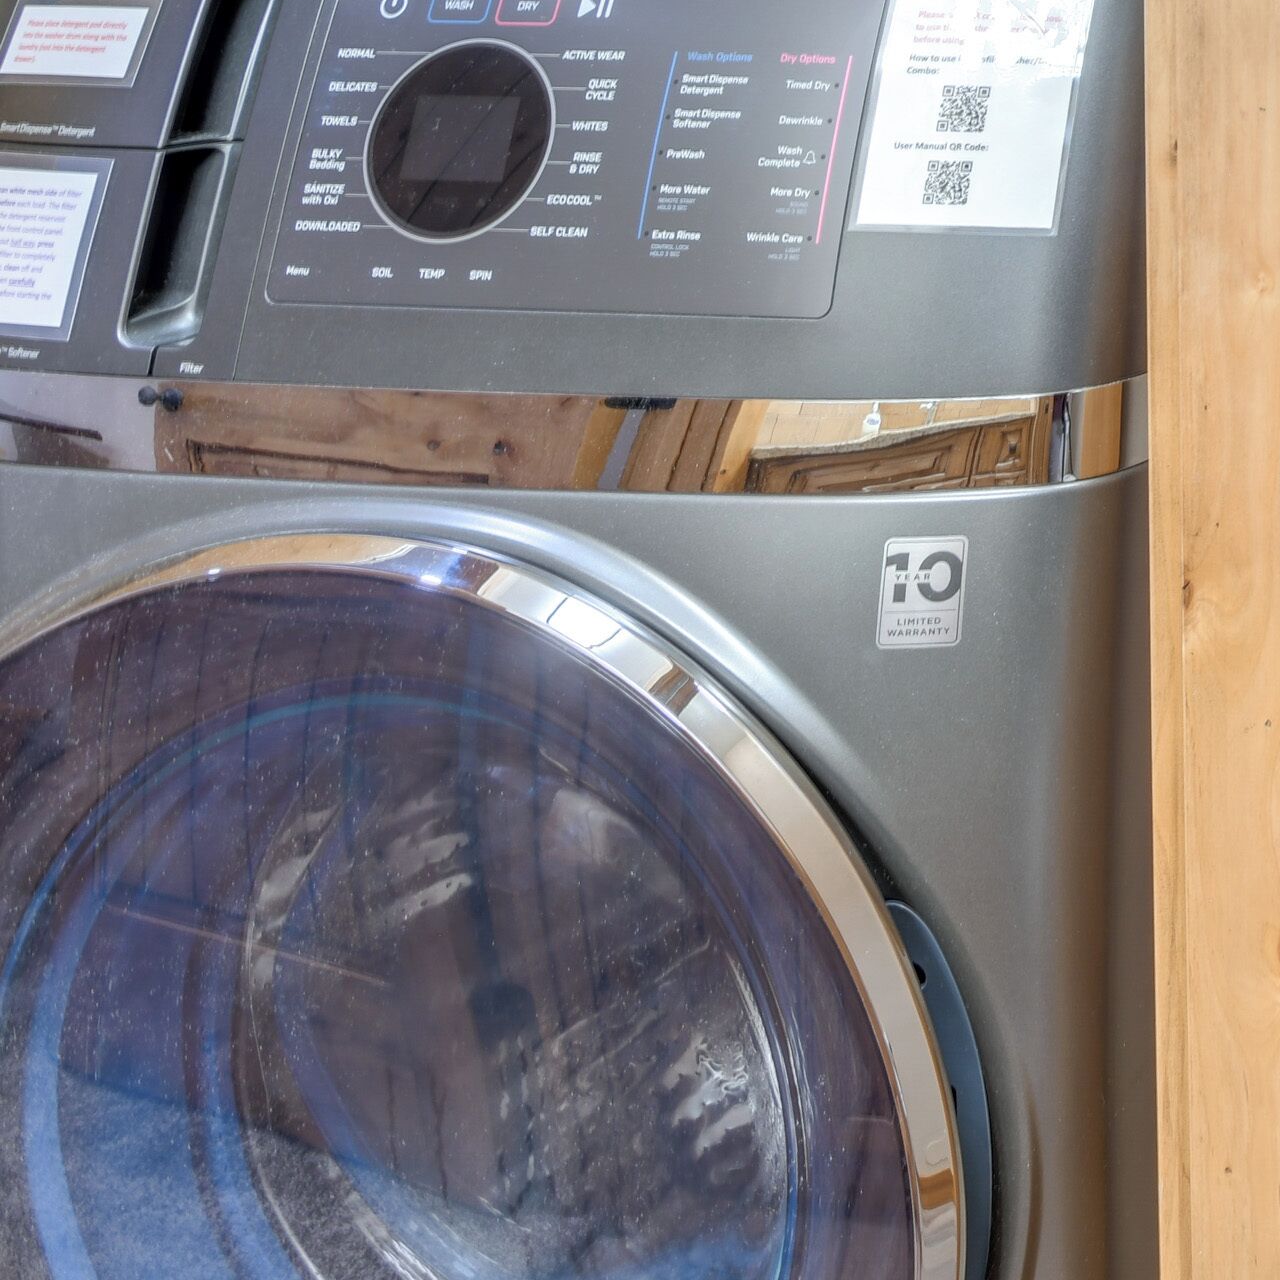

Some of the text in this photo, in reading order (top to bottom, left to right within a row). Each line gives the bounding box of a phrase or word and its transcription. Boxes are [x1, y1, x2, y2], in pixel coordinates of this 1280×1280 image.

[445, 0, 474, 11] WASH
[517, 1, 540, 12] DRY
[913, 35, 941, 45] before
[338, 48, 376, 59] NORMAL
[562, 50, 625, 61] ACTIVE WEAR
[687, 51, 753, 63] Wash Options
[780, 53, 836, 65] Dry Options
[909, 54, 929, 62] How
[906, 66, 940, 75] Combo:
[588, 78, 618, 90] QUICK
[682, 73, 749, 85] Smart Dispense
[329, 81, 378, 93] DELICATES
[680, 85, 724, 96] Detergent
[786, 80, 831, 92] Timed Dry
[585, 90, 616, 101] CYCLE
[674, 108, 741, 120] Smart Dispense
[321, 116, 359, 127] TOWELS
[672, 119, 712, 129] Softener
[779, 115, 823, 126] Dewrinkle
[572, 121, 609, 132] WHITES
[58, 126, 96, 139] Detergent
[777, 145, 803, 156] Wash
[894, 141, 990, 152] User Manual QR Code:
[311, 148, 344, 159] BULKY
[573, 152, 603, 163] RINSE
[666, 149, 706, 160] PreWash
[309, 160, 346, 172] Bedding
[758, 157, 801, 168] Complete
[579, 164, 600, 175] DRY
[304, 183, 345, 195] SANITIZE
[660, 184, 711, 195] More Water
[770, 187, 811, 199] More Dry
[302, 195, 339, 205] with Oxi
[295, 220, 361, 232] DOWNLOADED
[530, 226, 588, 238] SELF CLEAN
[652, 229, 701, 241] Extra Rinse
[746, 232, 803, 243] Wrinkle Care
[286, 265, 310, 276] Menu
[372, 267, 394, 278] SOIL
[419, 268, 446, 279] TEMP
[469, 270, 493, 281] SPIN
[8, 346, 40, 360] Softener
[180, 361, 204, 374] Filter
[886, 551, 963, 602] 10
[895, 573, 931, 581] YEAR
[897, 616, 942, 626] LIMITED
[887, 627, 950, 637] WARRANTY
